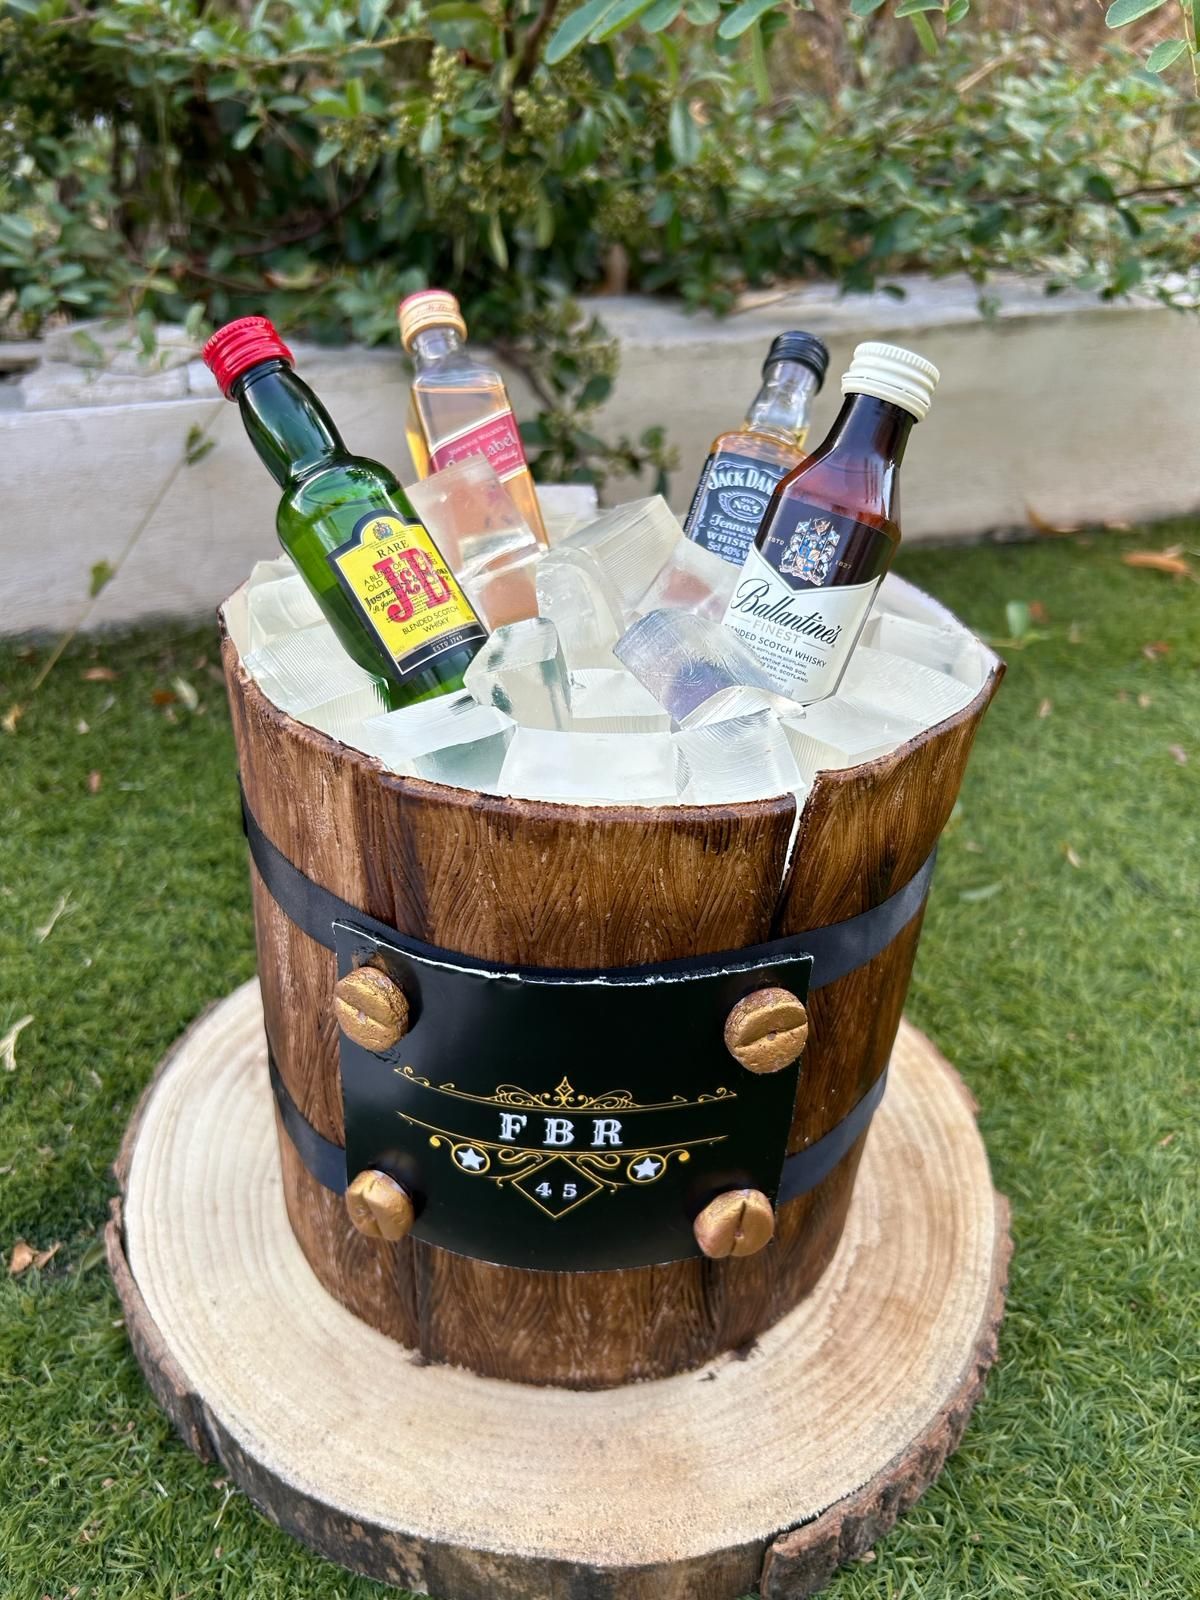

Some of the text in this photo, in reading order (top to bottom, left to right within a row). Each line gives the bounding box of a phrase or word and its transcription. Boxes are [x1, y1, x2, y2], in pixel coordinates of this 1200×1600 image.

[708, 470, 745, 490] JACK
[709, 514, 758, 537] Tenness
[377, 539, 410, 559] RARE
[369, 566, 391, 581] BLEND
[367, 580, 384, 592] OLD
[372, 548, 451, 623] J&B
[402, 615, 433, 635] BLENDED
[434, 606, 459, 619] SCOTCH
[731, 578, 842, 645] Ballantine's
[423, 617, 449, 633] WHISKY
[752, 619, 801, 644] FINEST
[758, 636, 793, 656] SCOTCH
[795, 650, 827, 669] WHISKY
